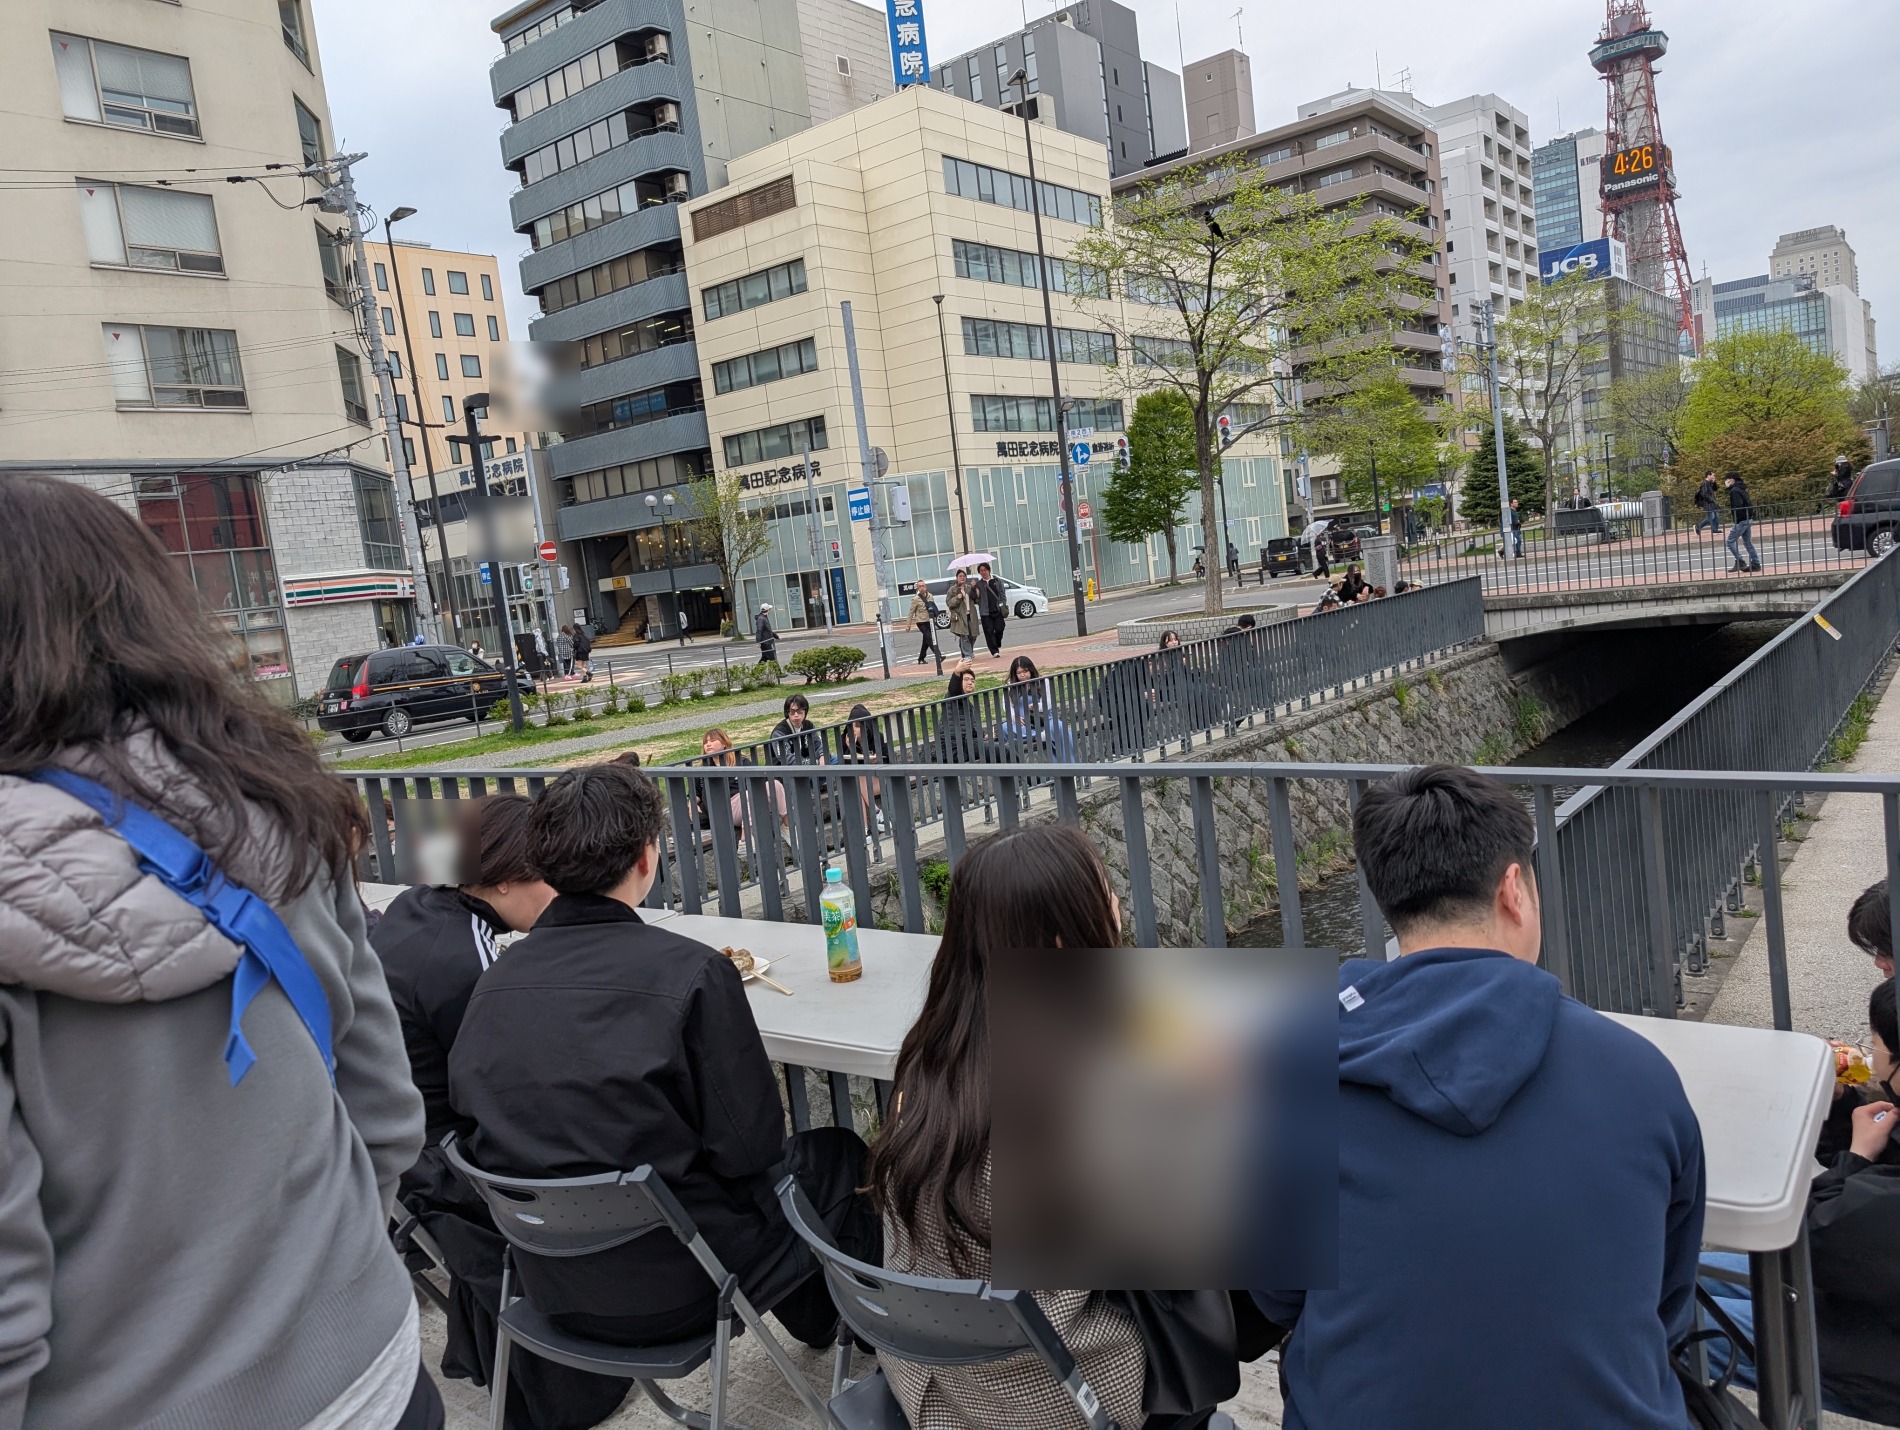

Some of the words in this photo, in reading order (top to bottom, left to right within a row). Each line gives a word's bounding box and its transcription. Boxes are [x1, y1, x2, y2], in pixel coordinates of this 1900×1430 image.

[894, 0, 923, 76] 急病院
[1614, 146, 1654, 175] 4:26
[1604, 172, 1659, 193] Panasonic
[1543, 253, 1599, 278] JCB
[850, 503, 871, 516] 停止線
